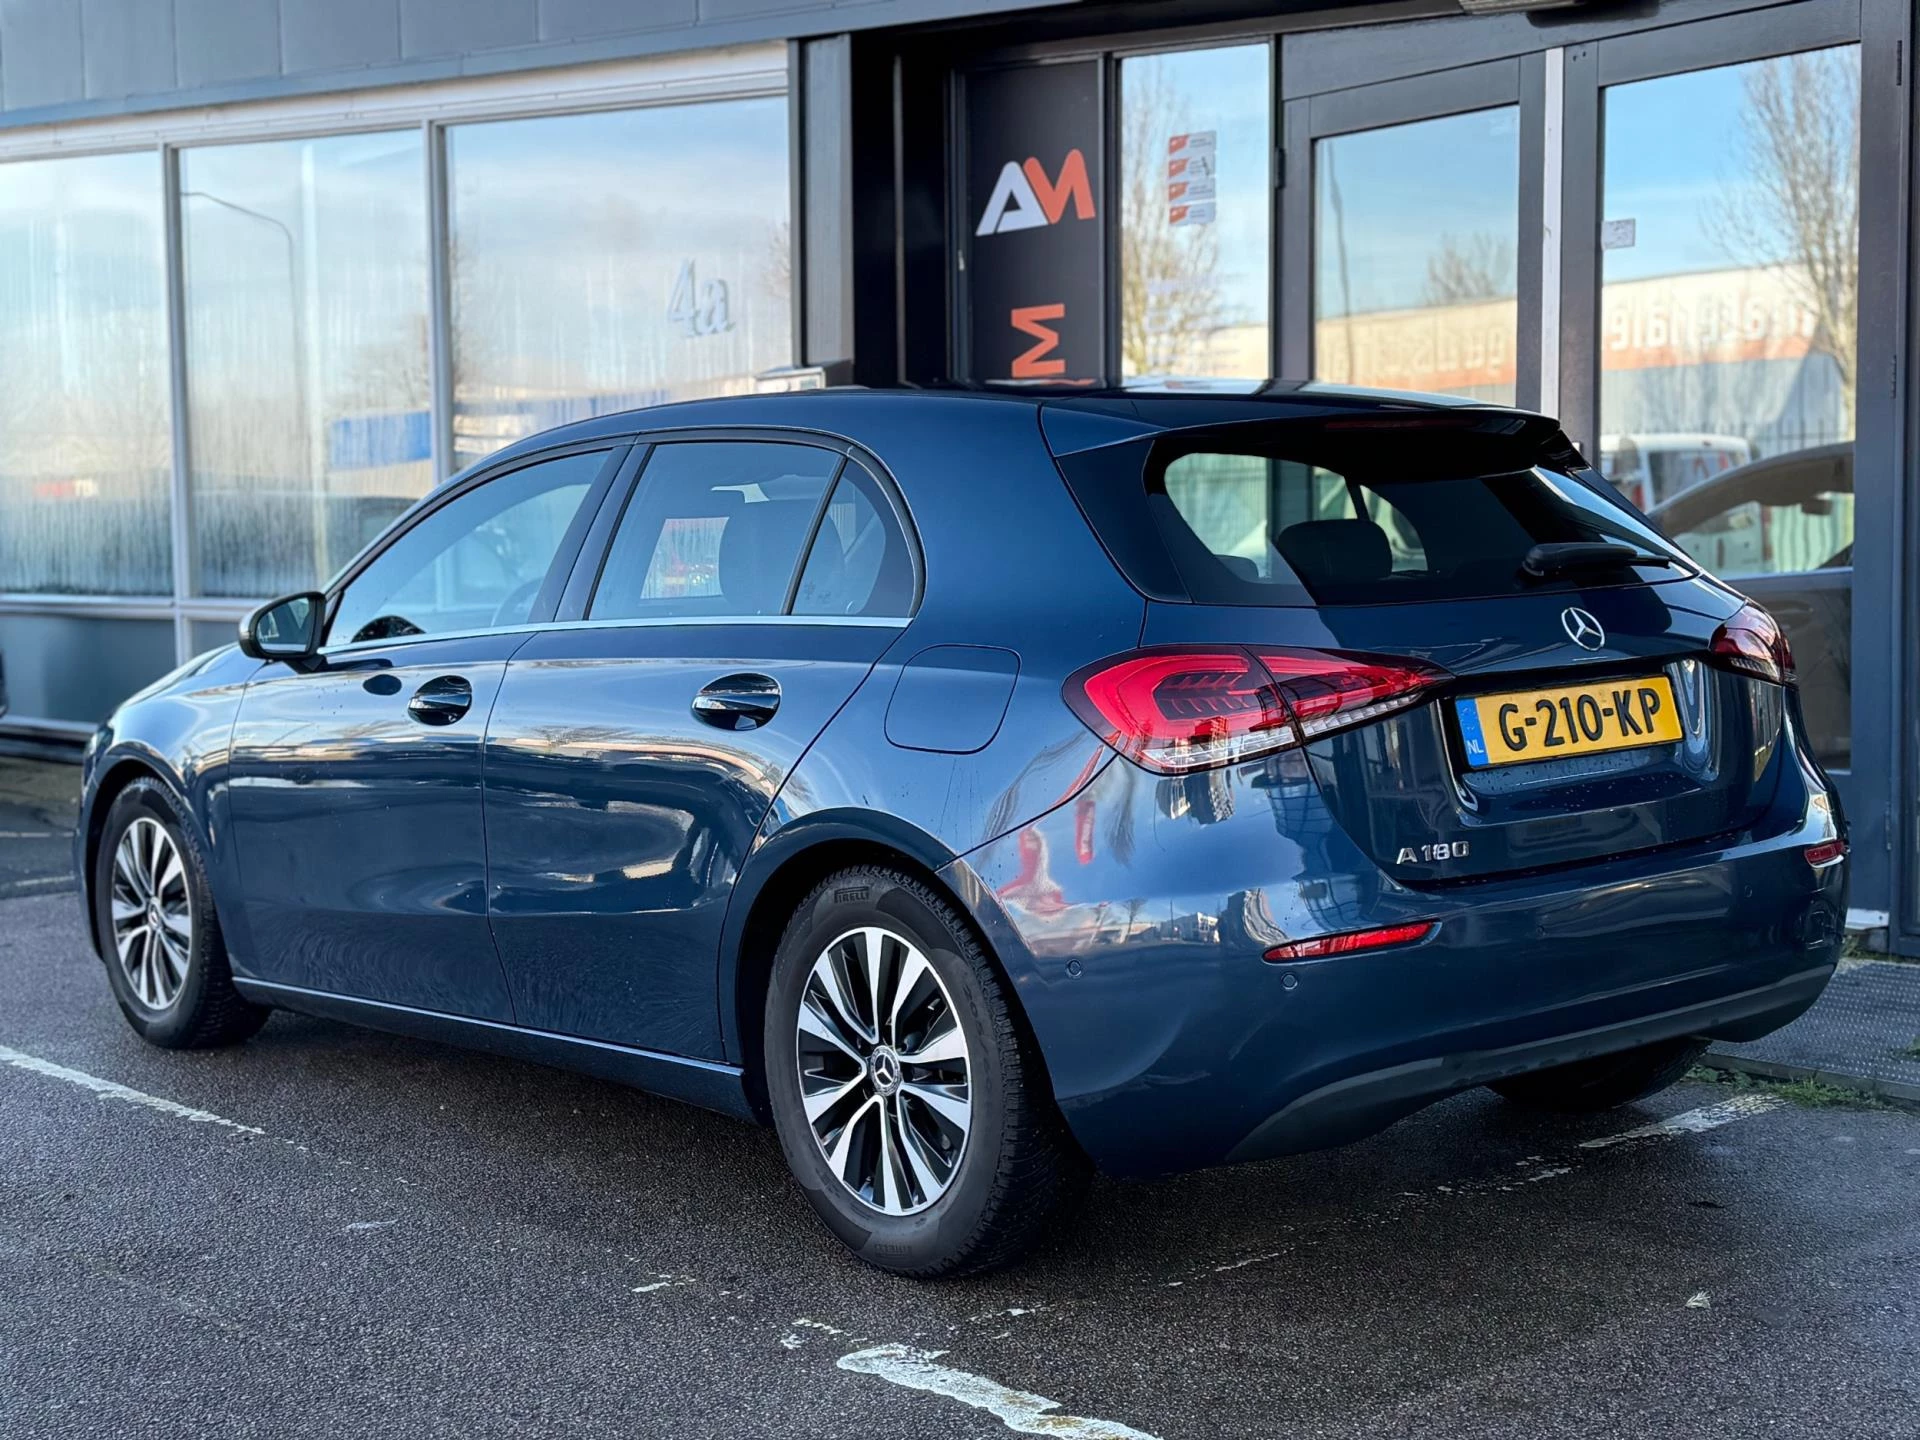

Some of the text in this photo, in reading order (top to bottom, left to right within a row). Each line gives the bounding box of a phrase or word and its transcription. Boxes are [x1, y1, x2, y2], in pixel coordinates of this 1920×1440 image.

[976, 148, 1096, 236] AM
[667, 257, 735, 338] 4a
[1499, 688, 1661, 751] G-210-KP
[1466, 738, 1484, 754] NL
[1396, 841, 1470, 865] A 180
[833, 886, 870, 904] PIRELLI
